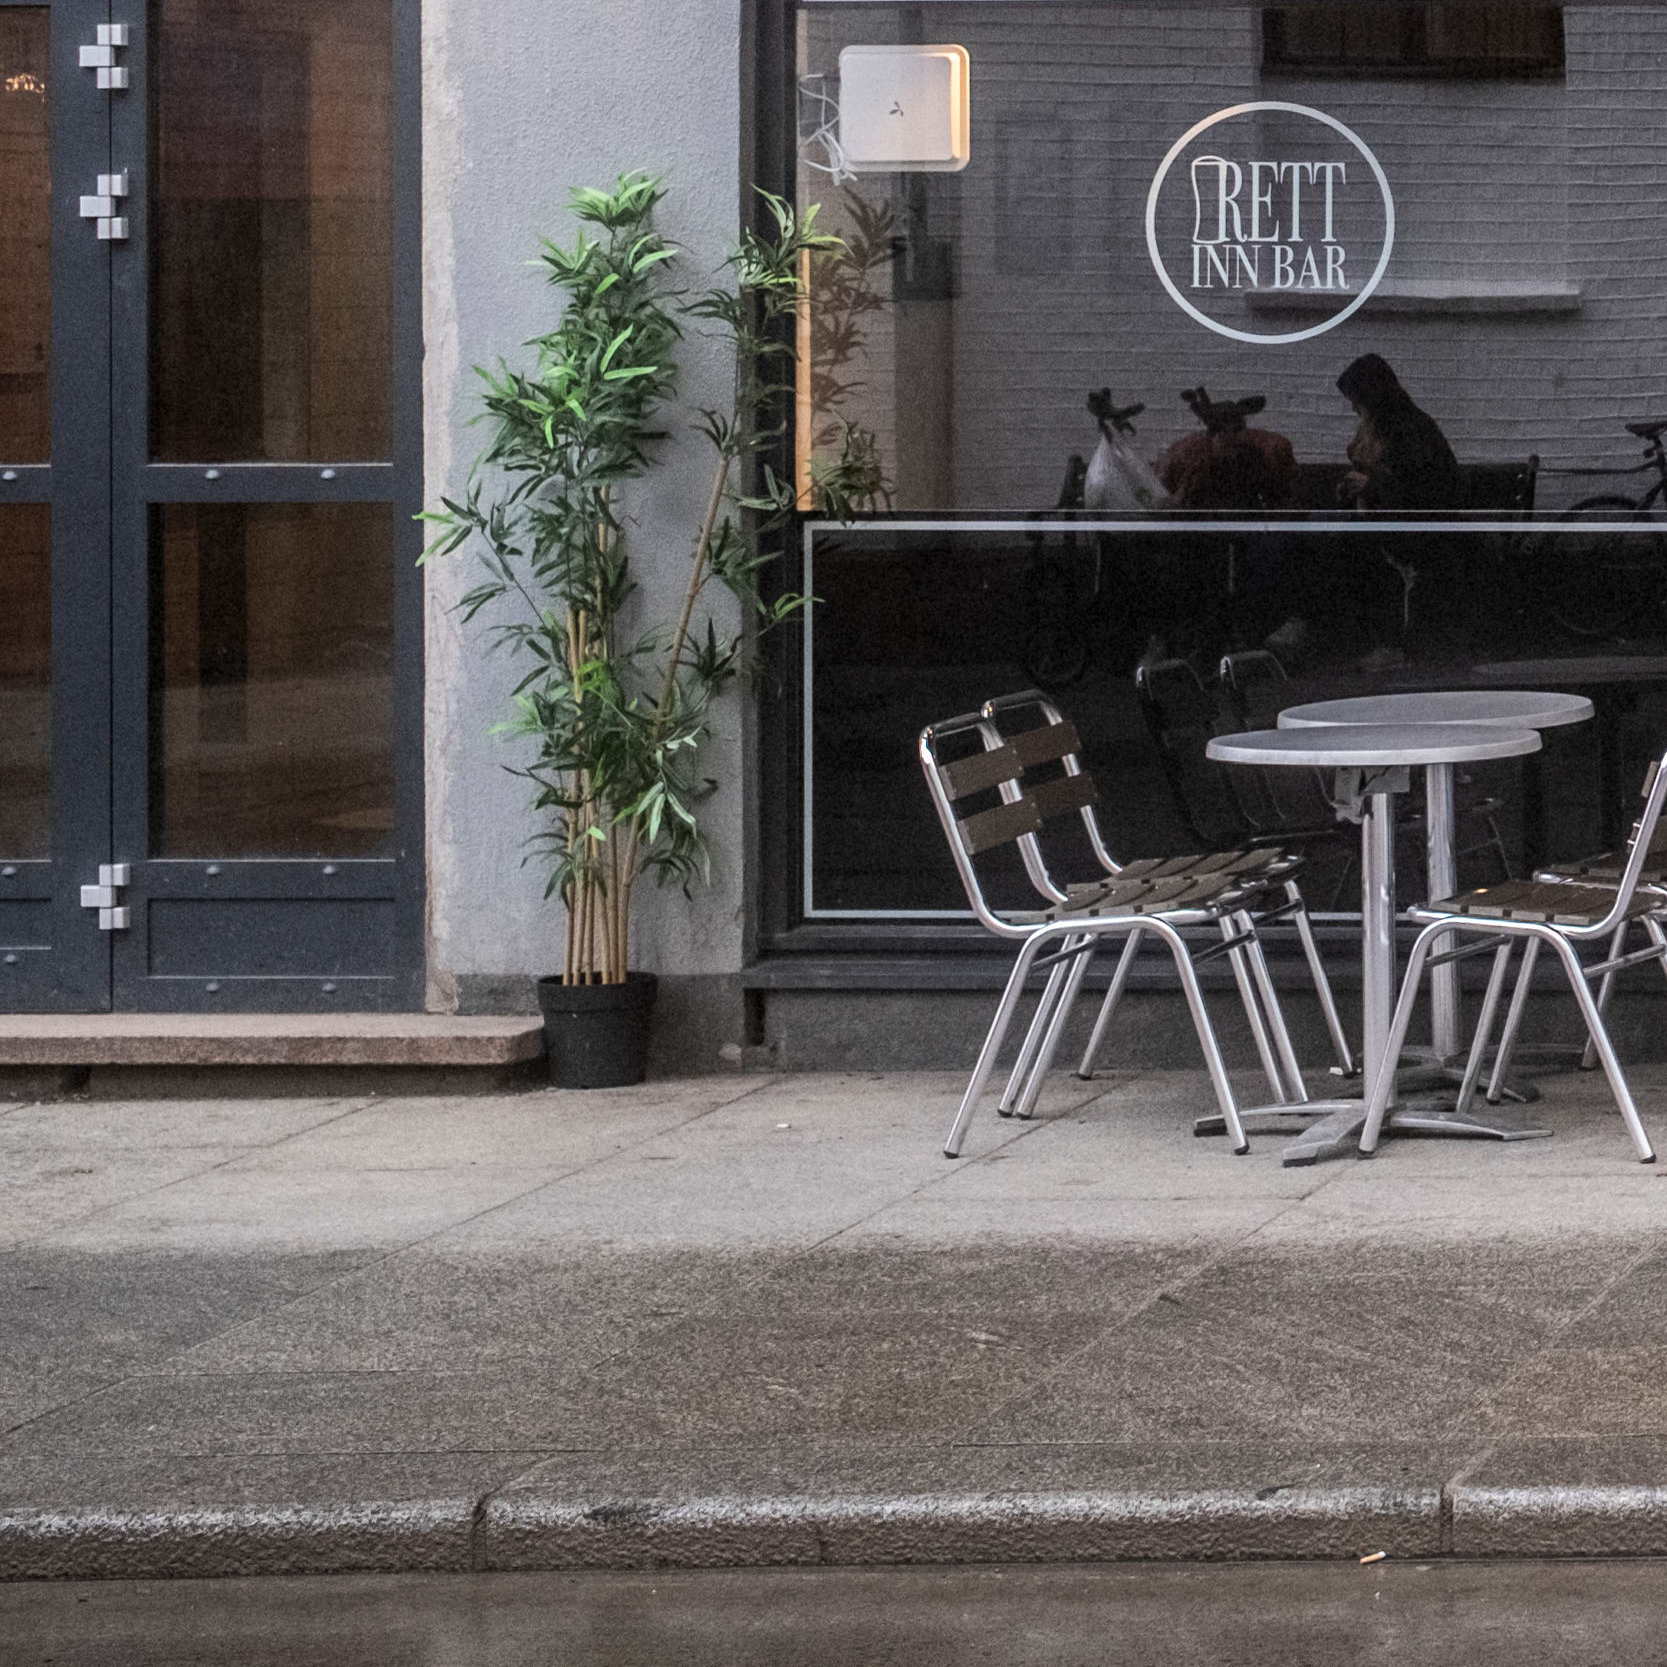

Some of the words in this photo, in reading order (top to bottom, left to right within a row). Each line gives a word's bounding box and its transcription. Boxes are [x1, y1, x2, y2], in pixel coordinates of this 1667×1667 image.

[1191, 155, 1347, 244] RETT
[1190, 244, 1261, 289] INN
[1272, 244, 1350, 290] BAR
